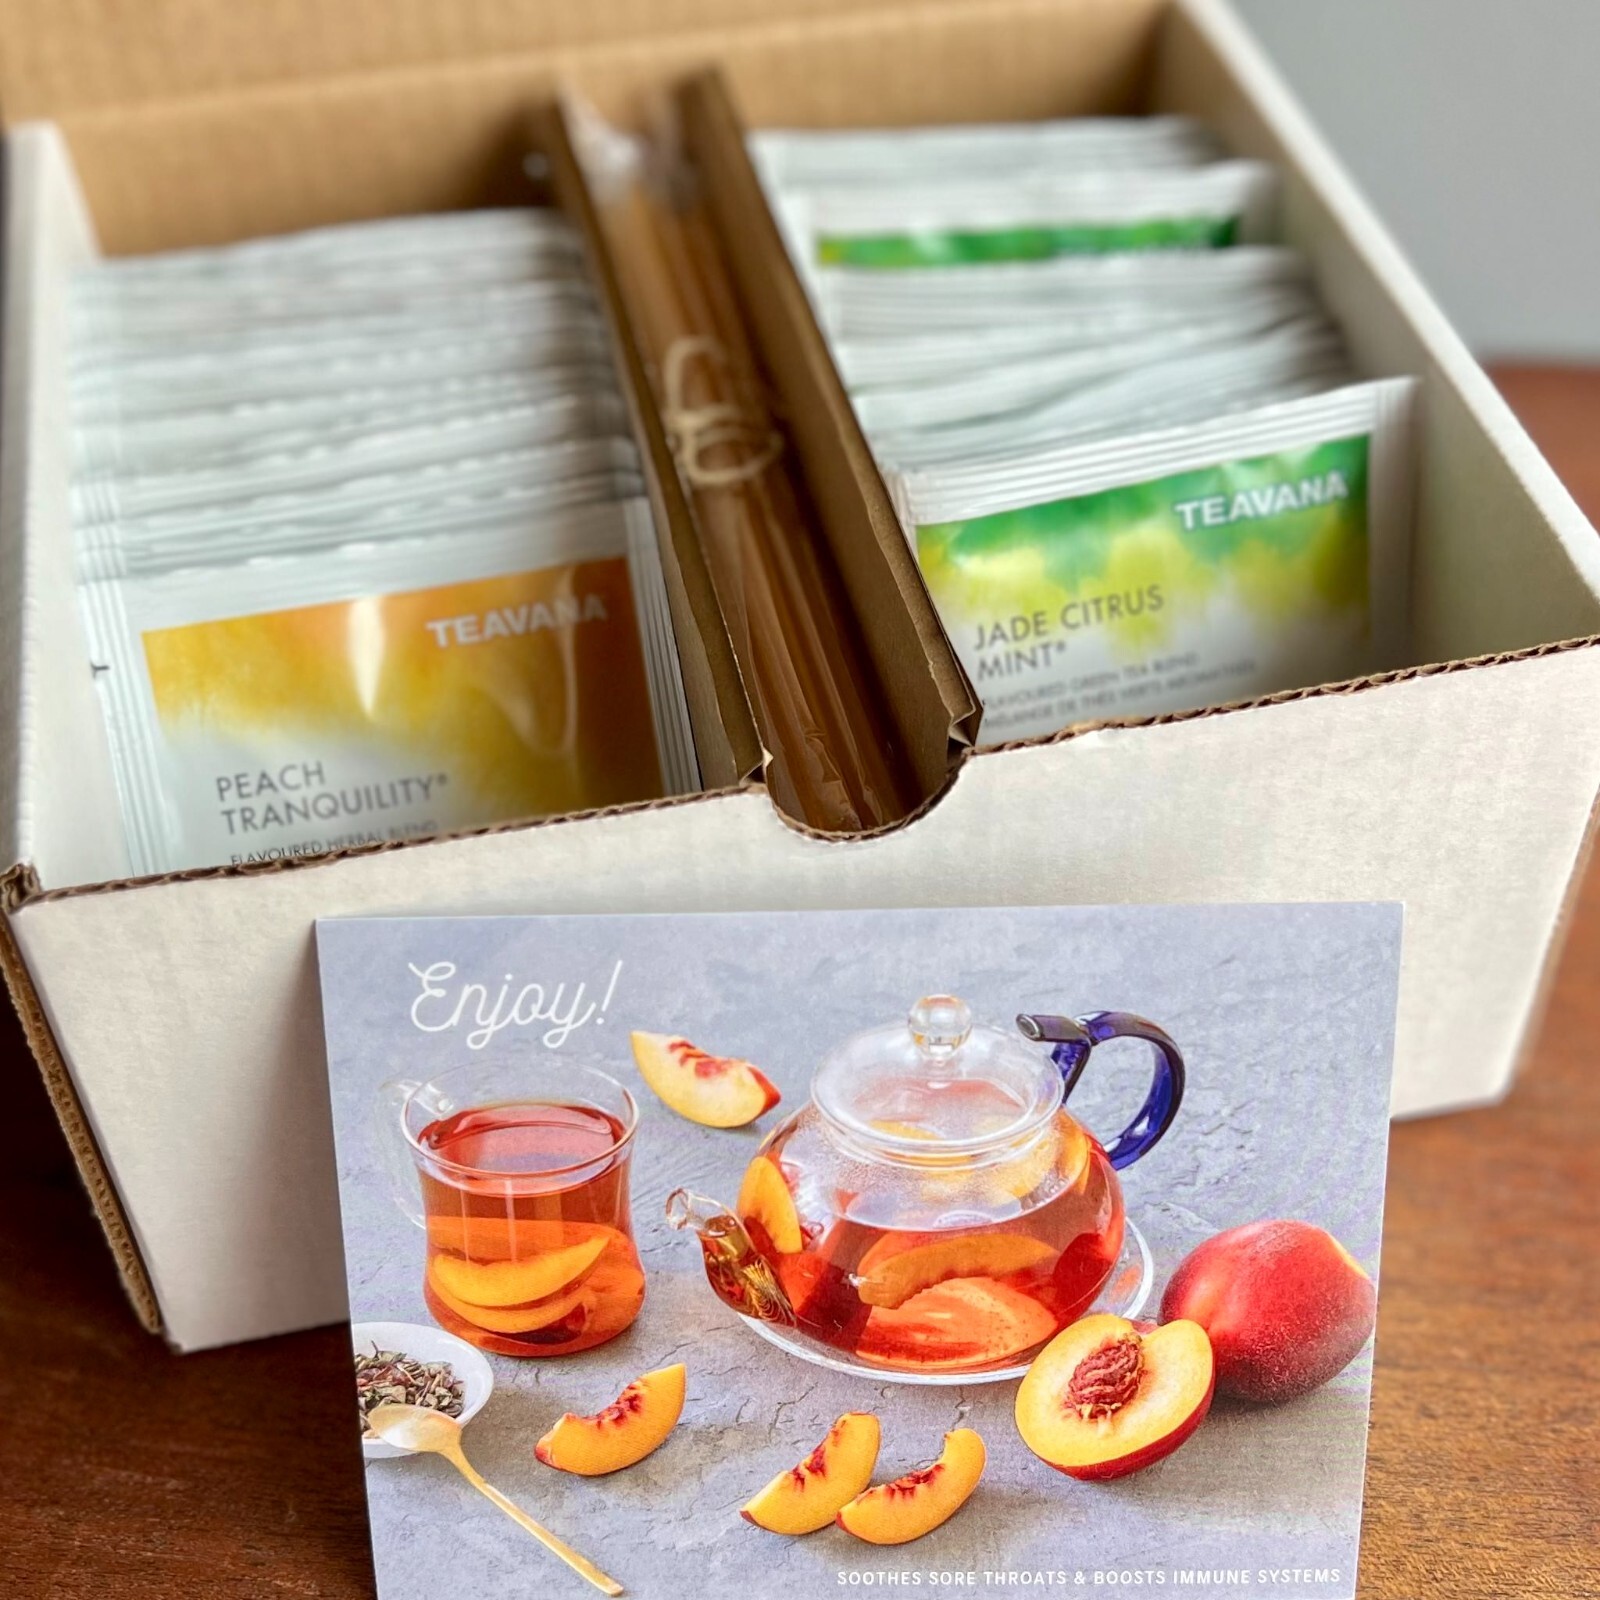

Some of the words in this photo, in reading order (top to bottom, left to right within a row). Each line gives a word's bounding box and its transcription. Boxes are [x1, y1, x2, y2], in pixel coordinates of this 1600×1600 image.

[1174, 470, 1349, 531] TEAVANA
[425, 593, 607, 648] TEAVANA
[974, 610, 1048, 650] JADE
[1060, 584, 1165, 630] CITRUS
[216, 760, 326, 803] PEACH
[408, 959, 623, 1050] Enjoy!
[836, 1571, 922, 1586] SOOTHES
[928, 1571, 976, 1586] SORE
[983, 1570, 1067, 1586] THROATS
[1073, 1570, 1086, 1585] &
[1093, 1570, 1166, 1585] BOOSTS
[1173, 1569, 1251, 1585] IMMUNE
[1257, 1568, 1341, 1584] SYSTEMS
